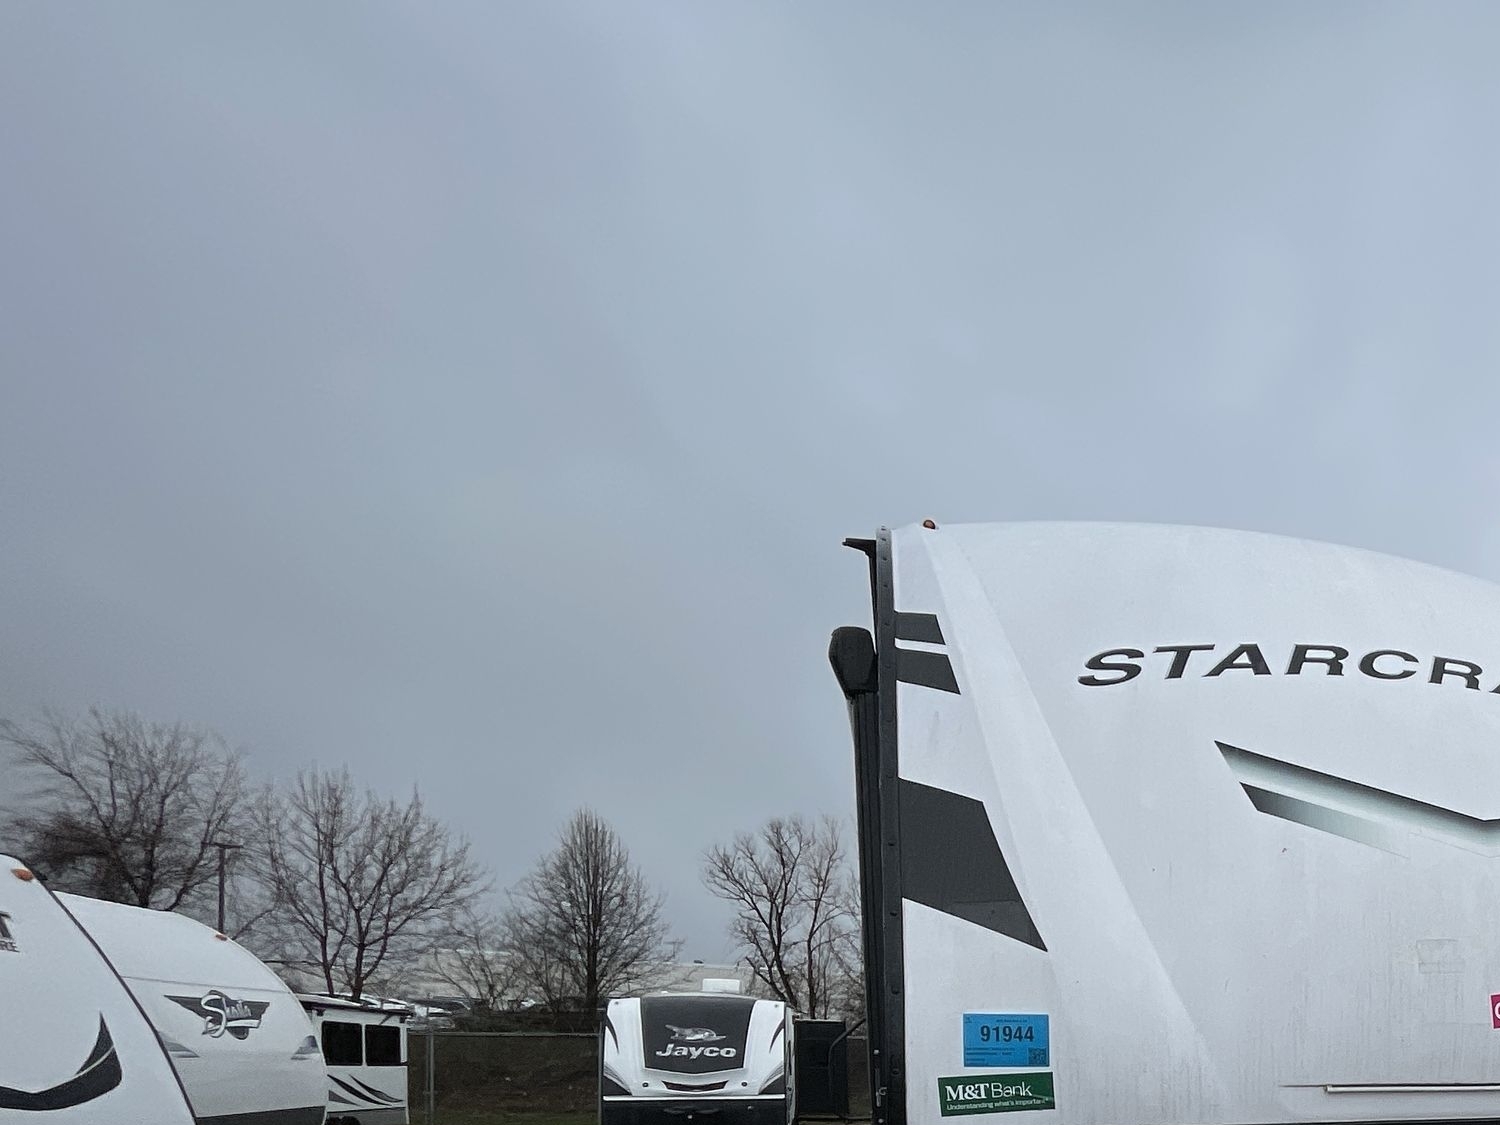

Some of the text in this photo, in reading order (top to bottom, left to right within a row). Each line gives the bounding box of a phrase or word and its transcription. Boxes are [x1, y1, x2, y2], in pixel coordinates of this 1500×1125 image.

[980, 1025, 1034, 1042] 91944
[655, 1043, 737, 1060] Jayco
[945, 1081, 1032, 1101] M&T Bank
